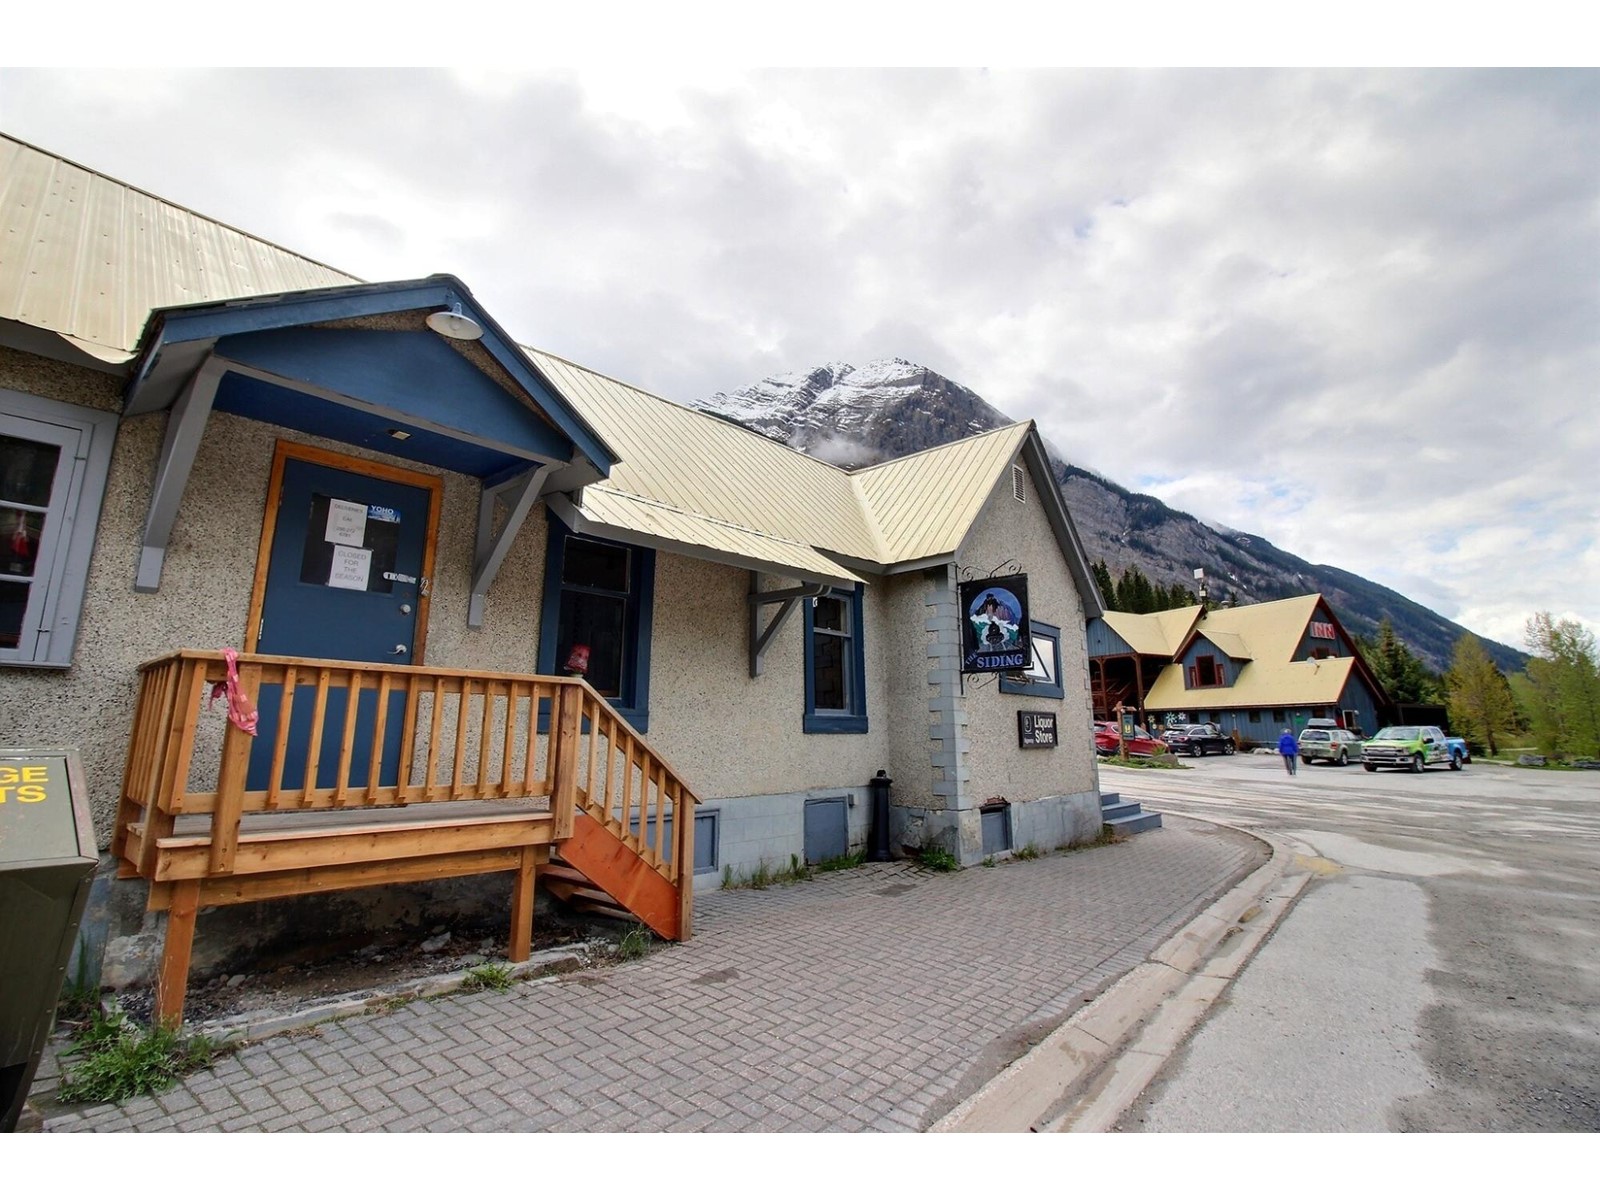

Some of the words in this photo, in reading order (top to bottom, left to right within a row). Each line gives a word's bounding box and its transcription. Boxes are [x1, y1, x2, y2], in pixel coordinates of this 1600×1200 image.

[371, 504, 394, 515] YOHO
[338, 550, 367, 560] CLOSED
[343, 559, 359, 567] FOR
[334, 572, 363, 582] SEASON
[1310, 621, 1336, 640] INN
[965, 651, 978, 665] THE
[976, 653, 1024, 668] SIDING
[1034, 715, 1053, 731] Liquor
[1035, 730, 1053, 744] Store
